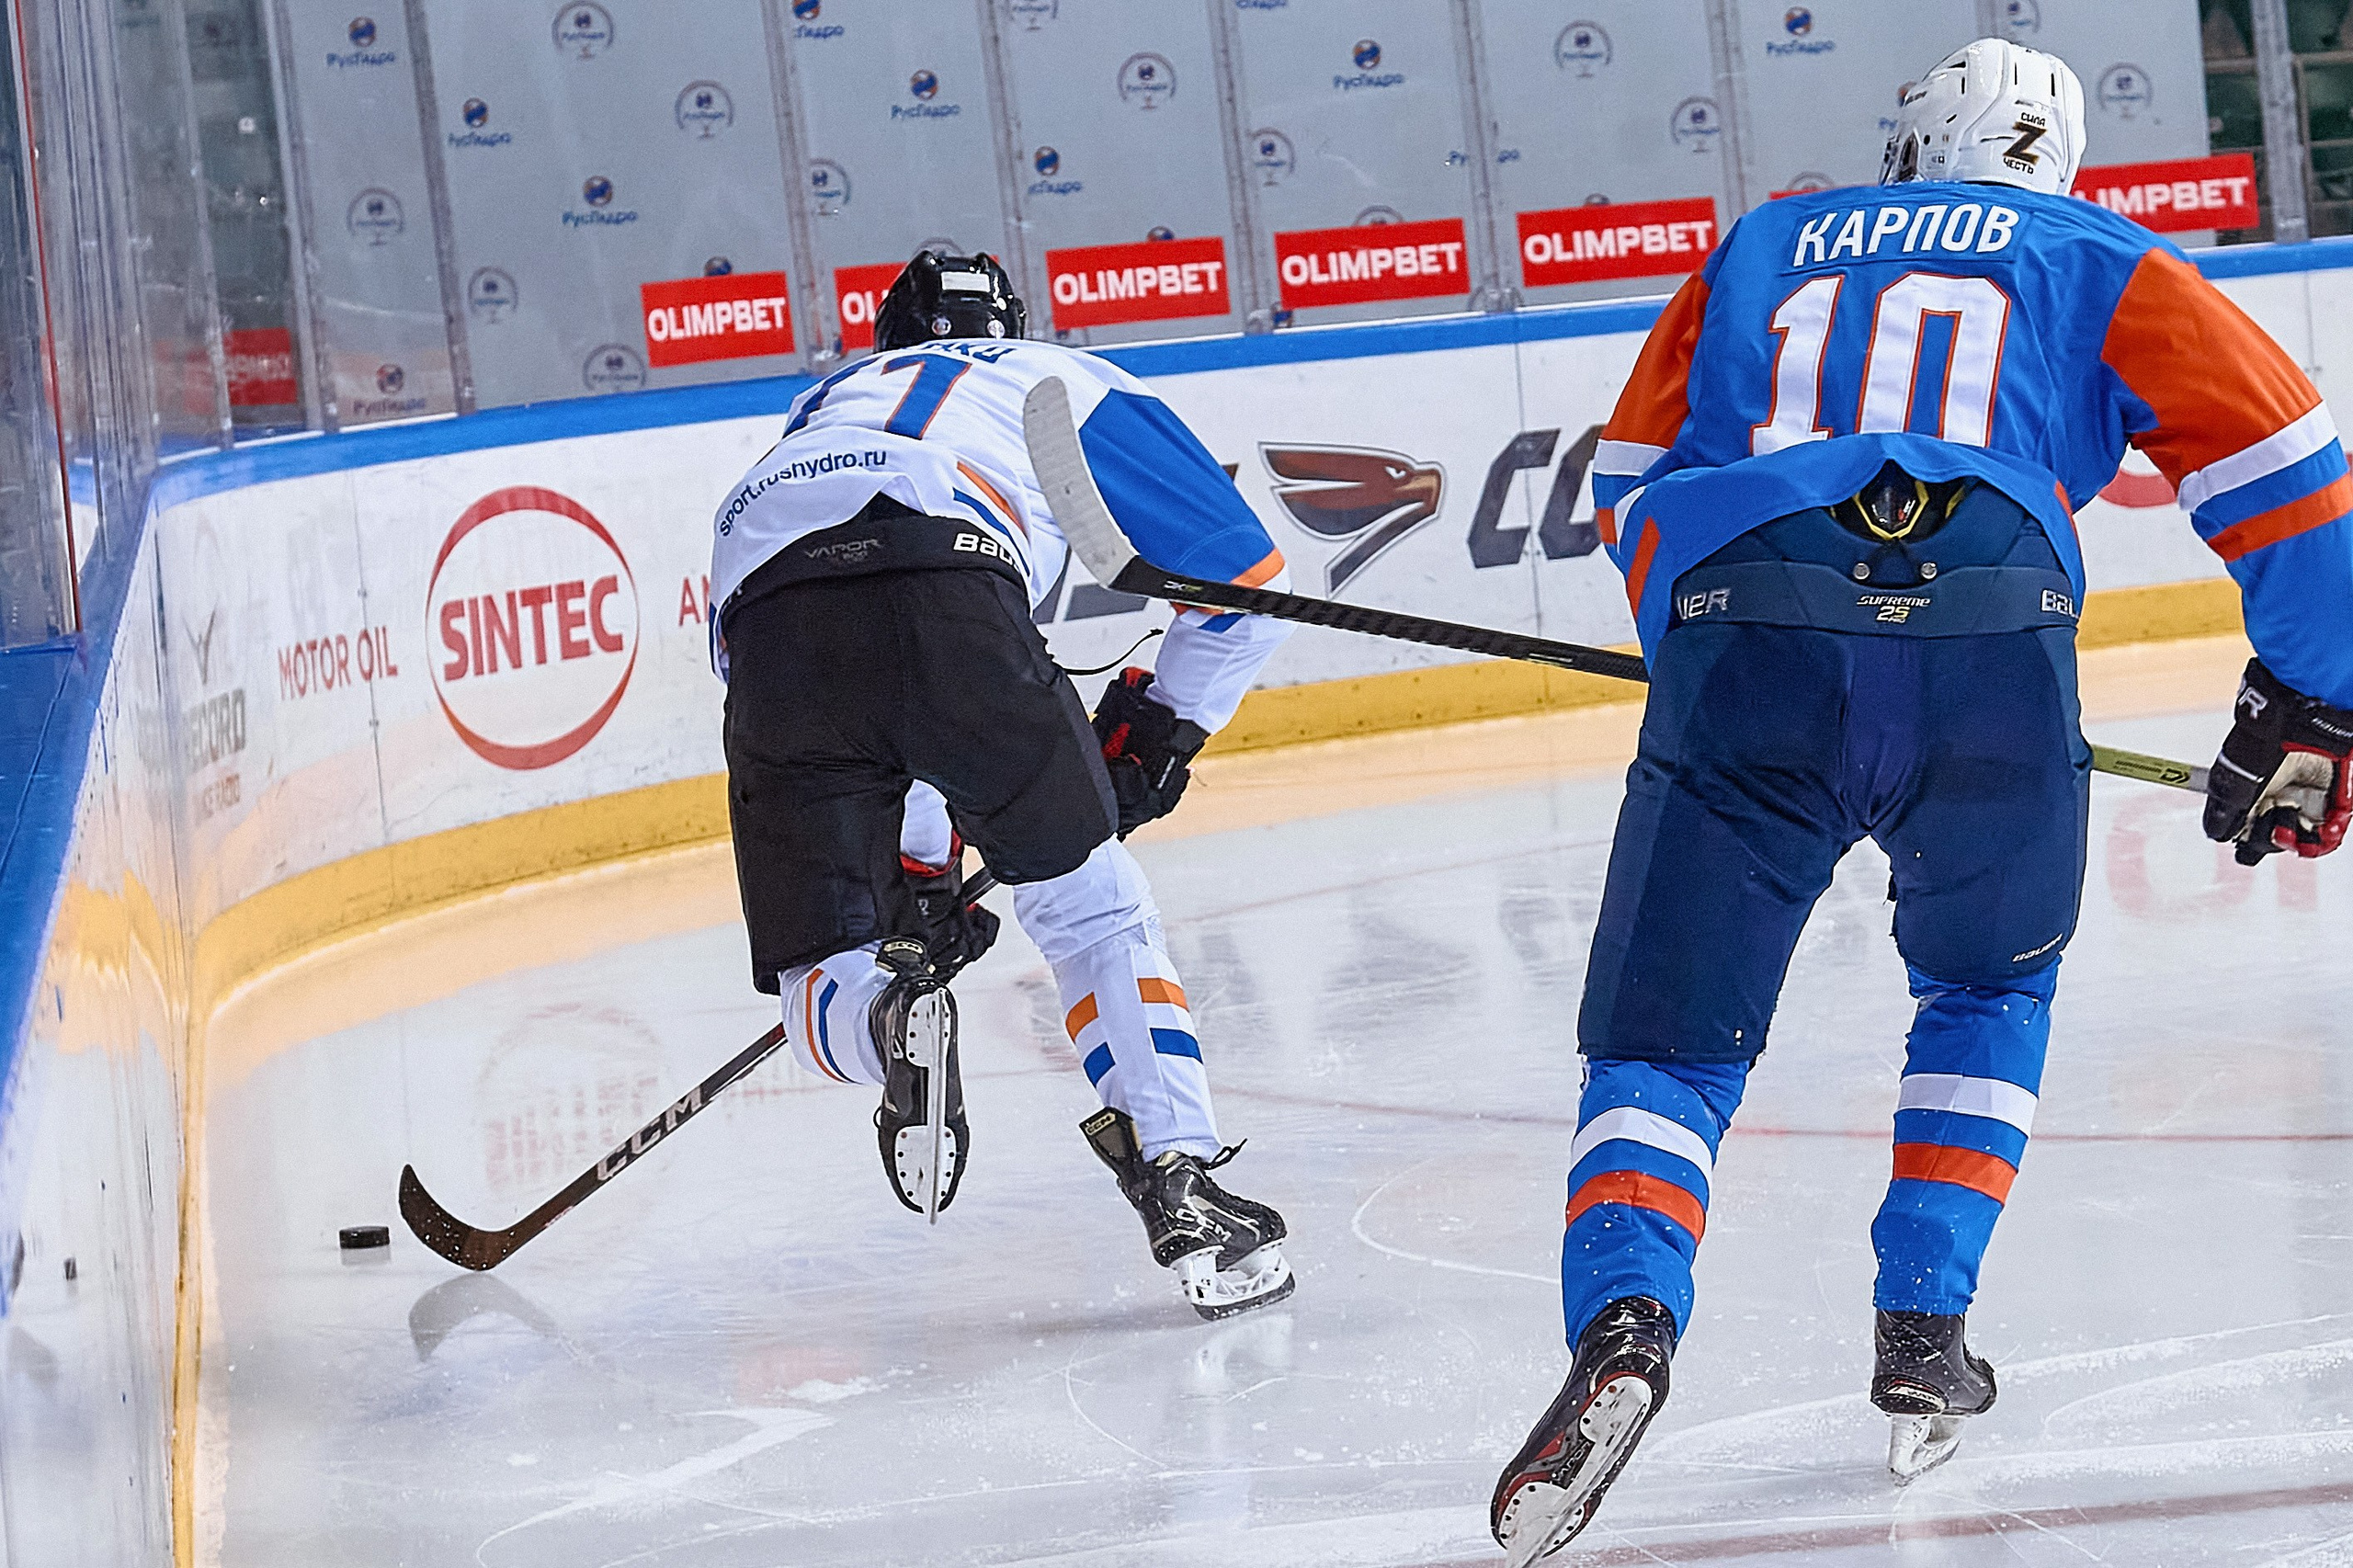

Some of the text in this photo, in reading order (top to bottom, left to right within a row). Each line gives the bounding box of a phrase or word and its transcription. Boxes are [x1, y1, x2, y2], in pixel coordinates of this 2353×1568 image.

[2021, 112, 2045, 126] СИЛА
[2003, 122, 2047, 165] Z
[2003, 157, 2034, 175] ЧЕСТЬ
[2075, 177, 2250, 215] IMPBET
[1524, 220, 1713, 265] OLIMPBET
[1793, 202, 2020, 267] КАРПОВ
[1053, 260, 1222, 305] OLIMPBET
[1281, 241, 1462, 287] OLIMPBET
[647, 296, 787, 343] OLIMPBET
[1749, 270, 2012, 458] 10
[720, 450, 887, 537] sport.rushydro.ru
[804, 539, 883, 559] VAPOR
[439, 574, 624, 682] SINTEC
[278, 626, 399, 701] MOTOR OIL
[597, 1085, 702, 1181] CCM
